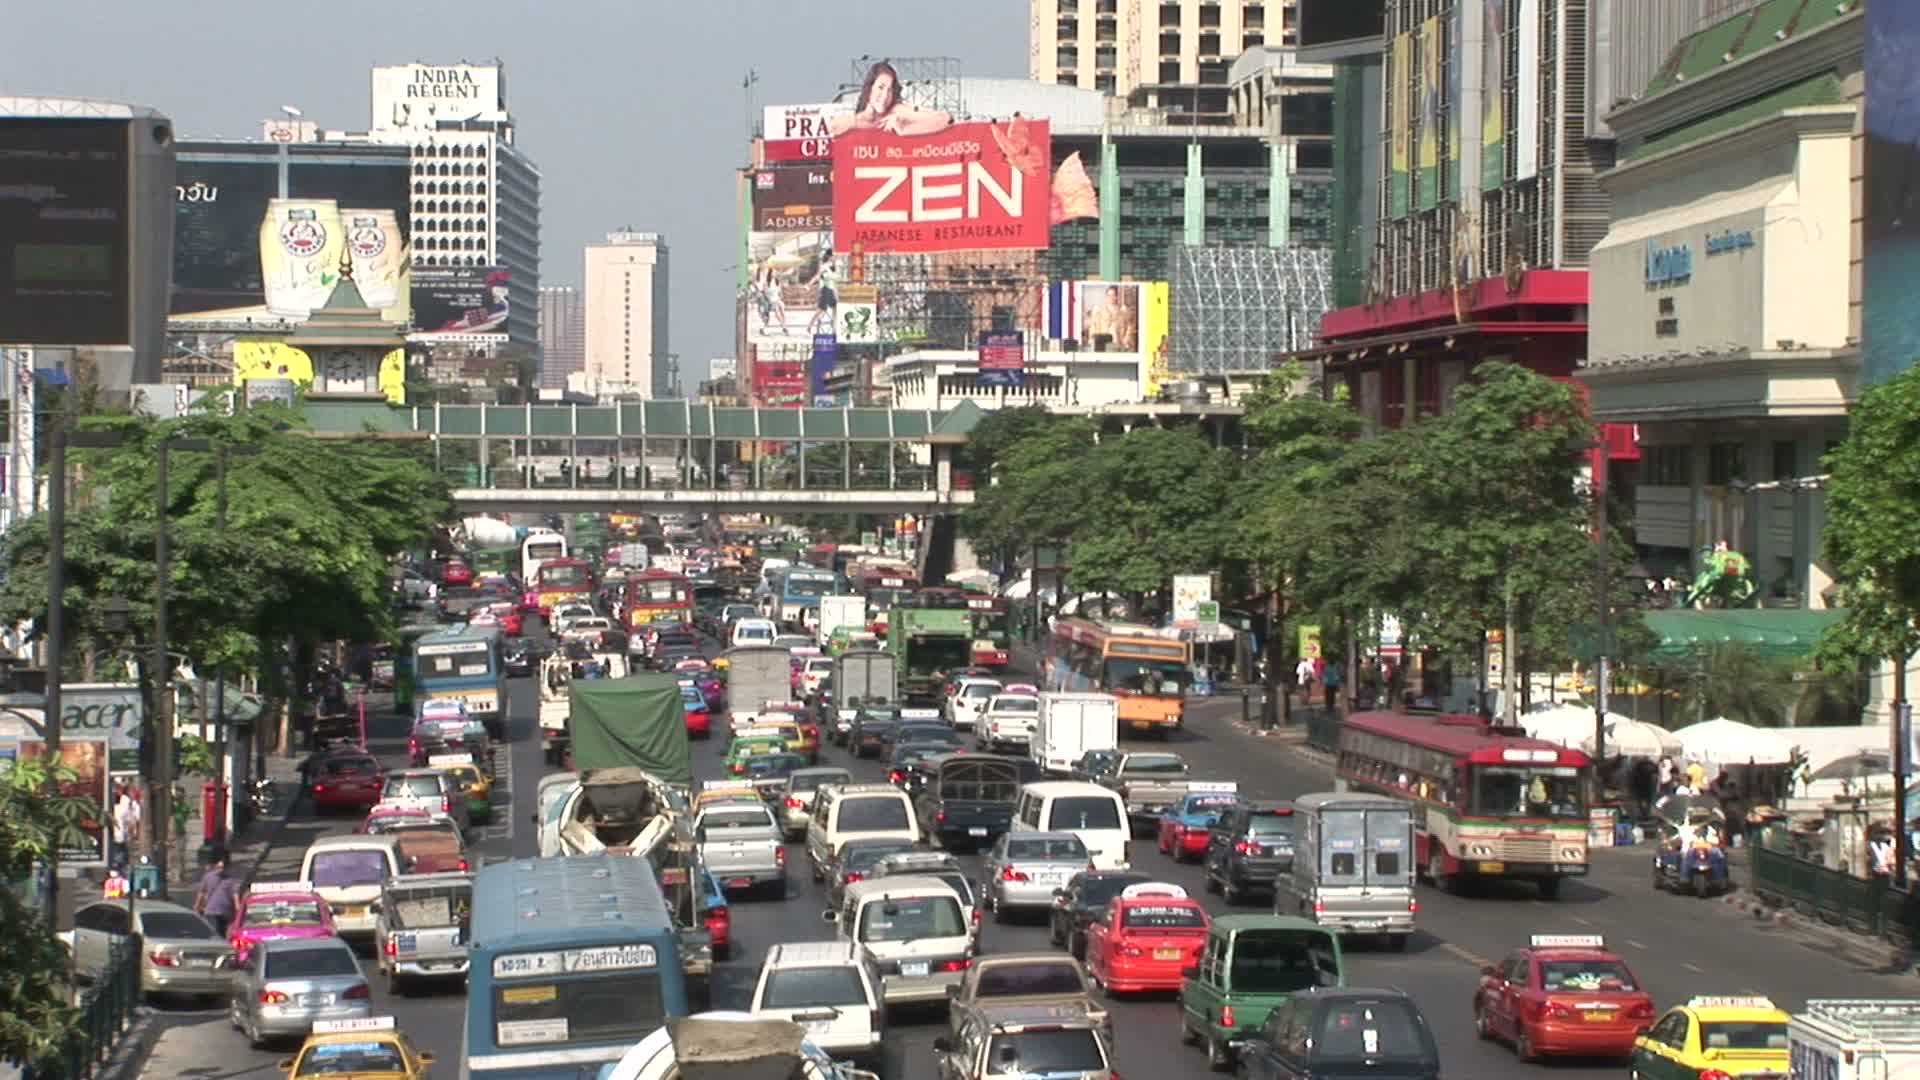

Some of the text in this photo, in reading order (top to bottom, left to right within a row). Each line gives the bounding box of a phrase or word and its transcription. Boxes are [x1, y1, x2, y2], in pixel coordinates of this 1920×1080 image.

[415, 69, 473, 84] INDRA
[407, 84, 480, 98] REGENT
[854, 161, 1023, 223] ZEN
[766, 215, 833, 228] ADDRESS
[855, 223, 1024, 242] JAPANESE RESTAURANT
[62, 703, 133, 730] acer
